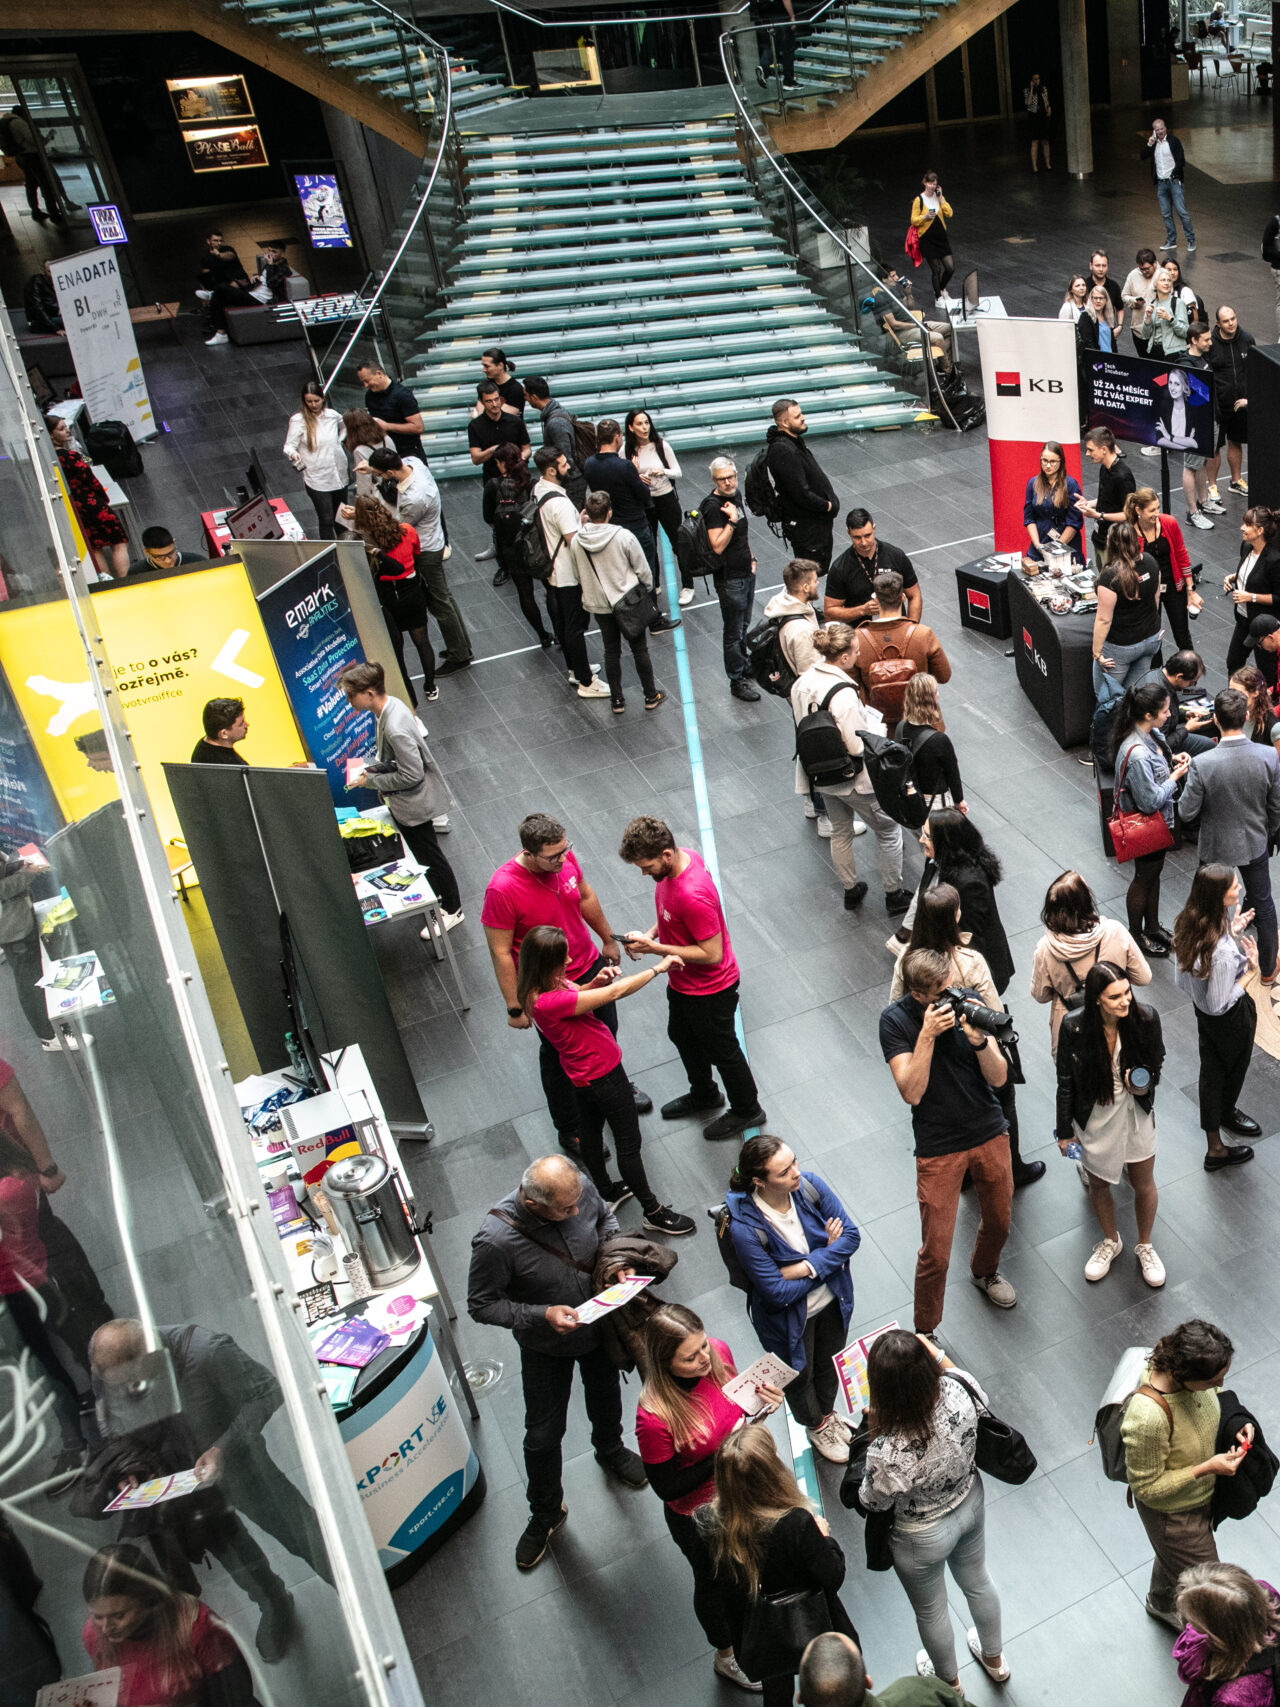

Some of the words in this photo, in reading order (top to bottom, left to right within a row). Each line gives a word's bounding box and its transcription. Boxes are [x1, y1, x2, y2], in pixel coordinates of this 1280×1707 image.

[57, 259, 117, 291] ENADATA
[74, 296, 91, 317] BI
[92, 308, 108, 320] DWH
[1029, 378, 1064, 393] KB
[1093, 379, 1104, 388] UŽ
[1104, 382, 1115, 390] ZA
[1123, 385, 1149, 397] MĚSÍCE
[1109, 390, 1124, 400] VÁS
[1125, 395, 1153, 406] EXPERT
[1094, 398, 1105, 406] NA
[1106, 399, 1126, 410] DATA
[285, 583, 335, 628] emark
[308, 599, 338, 626] ANALYTICS
[112, 665, 126, 679] je
[129, 662, 145, 672] to
[148, 659, 158, 667] o
[162, 648, 197, 664] vás?
[295, 657, 318, 678] Associative
[325, 634, 347, 652] Modelling
[303, 669, 318, 686] SaaS
[318, 661, 328, 674] Data
[328, 638, 358, 663] Protection
[1034, 648, 1048, 677] KB
[308, 680, 322, 693] Smart
[323, 728, 336, 741] Cloud
[335, 721, 345, 735] Data
[354, 717, 373, 735] Planning
[335, 753, 347, 767] Data
[347, 729, 369, 754] Analytics
[297, 1138, 324, 1155] Red
[325, 1128, 350, 1146] Bull
[406, 1413, 449, 1468] Accelerator
[408, 1485, 455, 1535] xport.vse.cz
